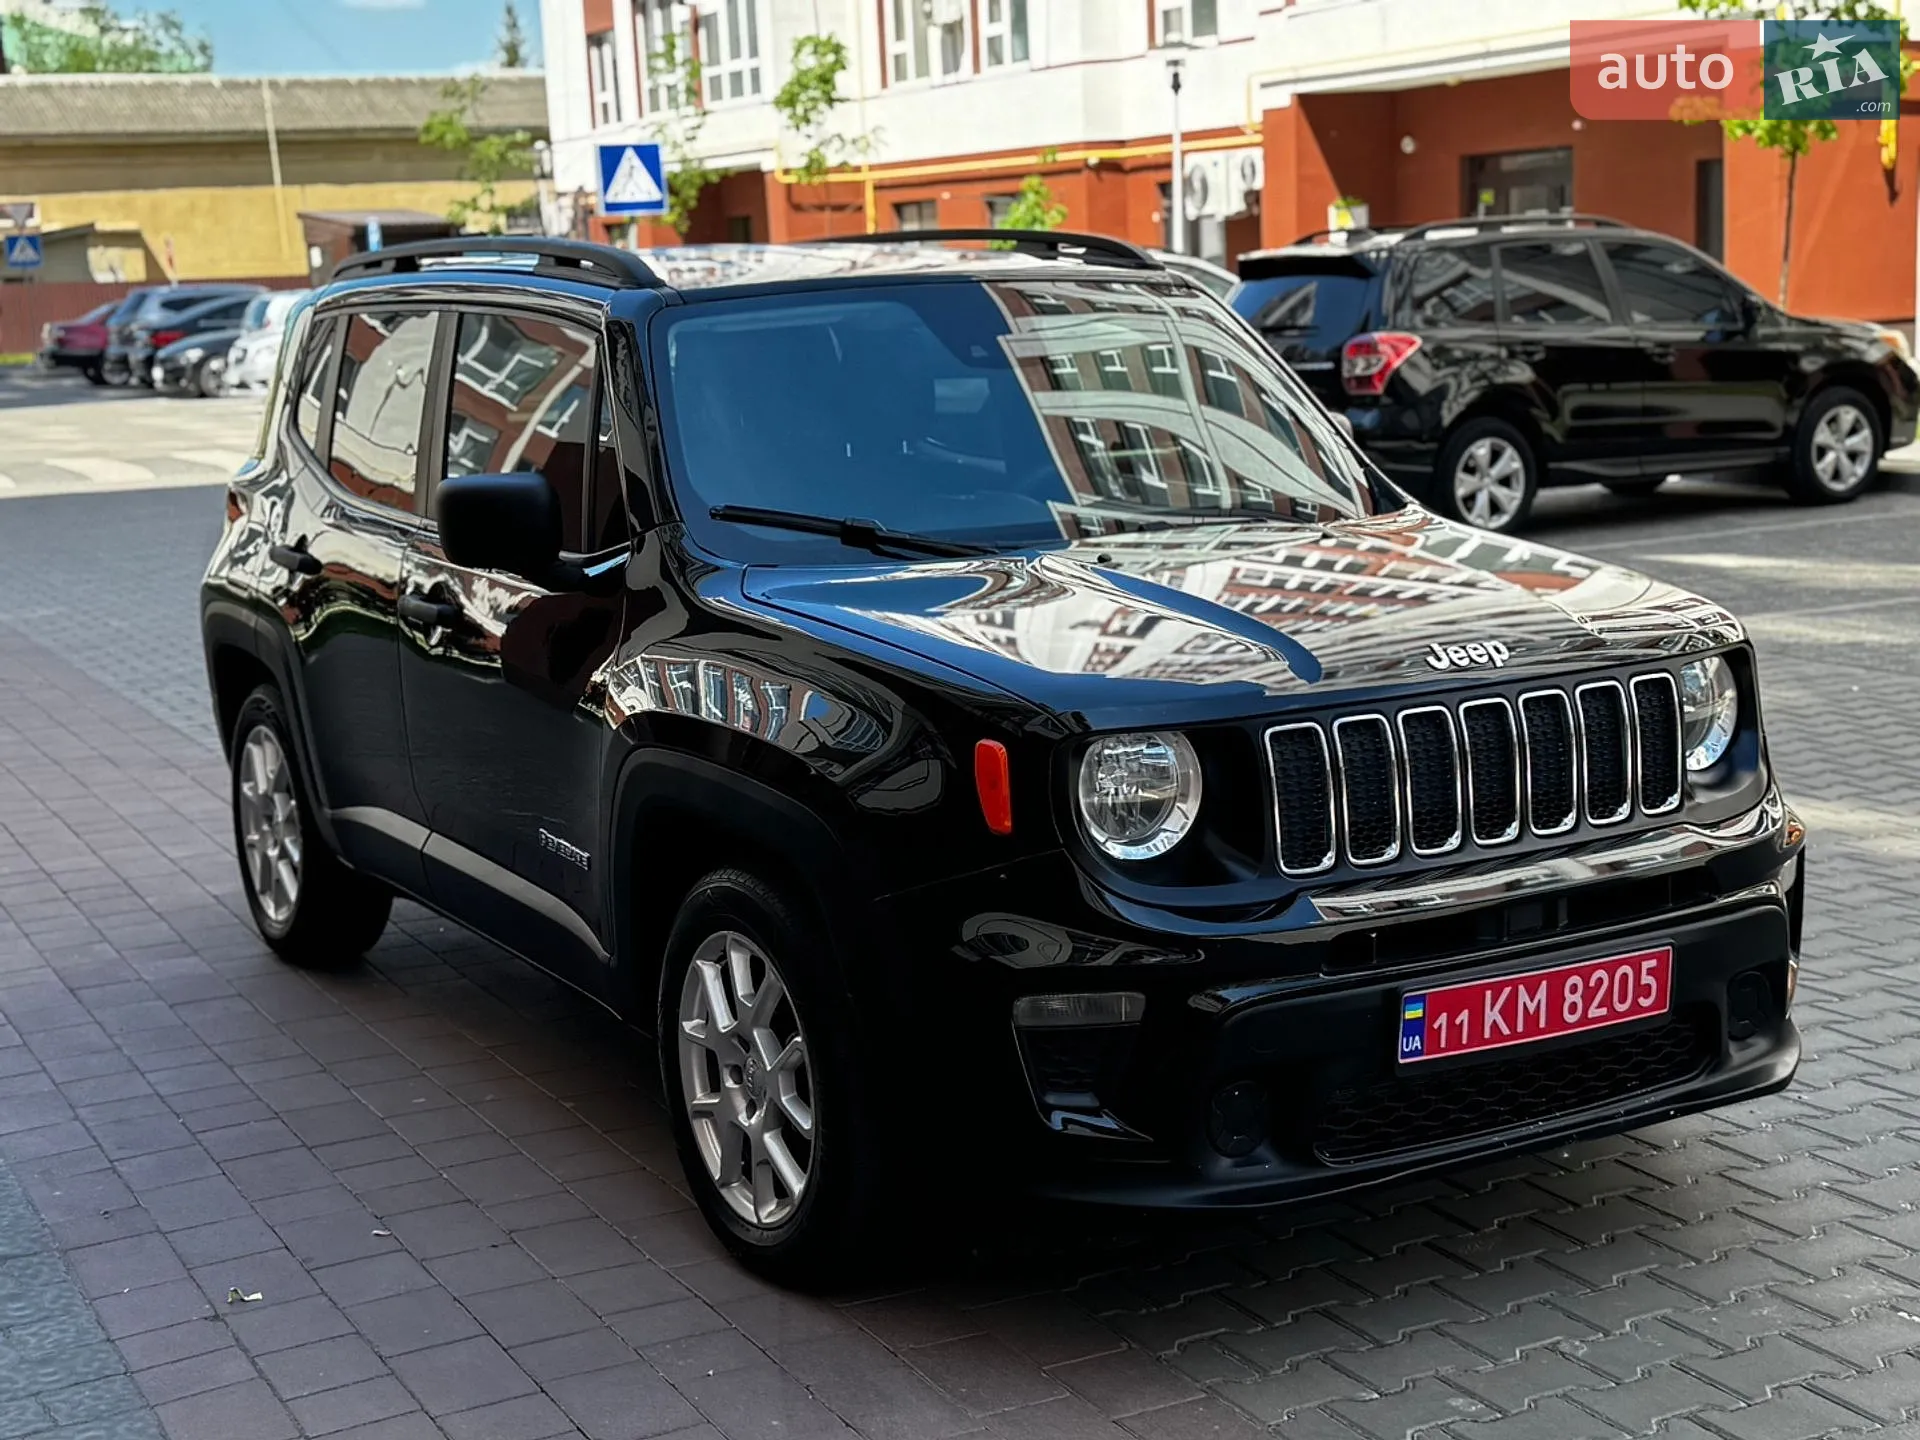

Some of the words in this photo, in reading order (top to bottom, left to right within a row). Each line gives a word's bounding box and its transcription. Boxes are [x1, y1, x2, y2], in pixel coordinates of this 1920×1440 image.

[1426, 641, 1510, 670] Jeep
[1432, 1008, 1470, 1049] 11
[1484, 980, 1548, 1039] KM
[1562, 959, 1658, 1024] 8205
[1402, 1035, 1422, 1052] UA
